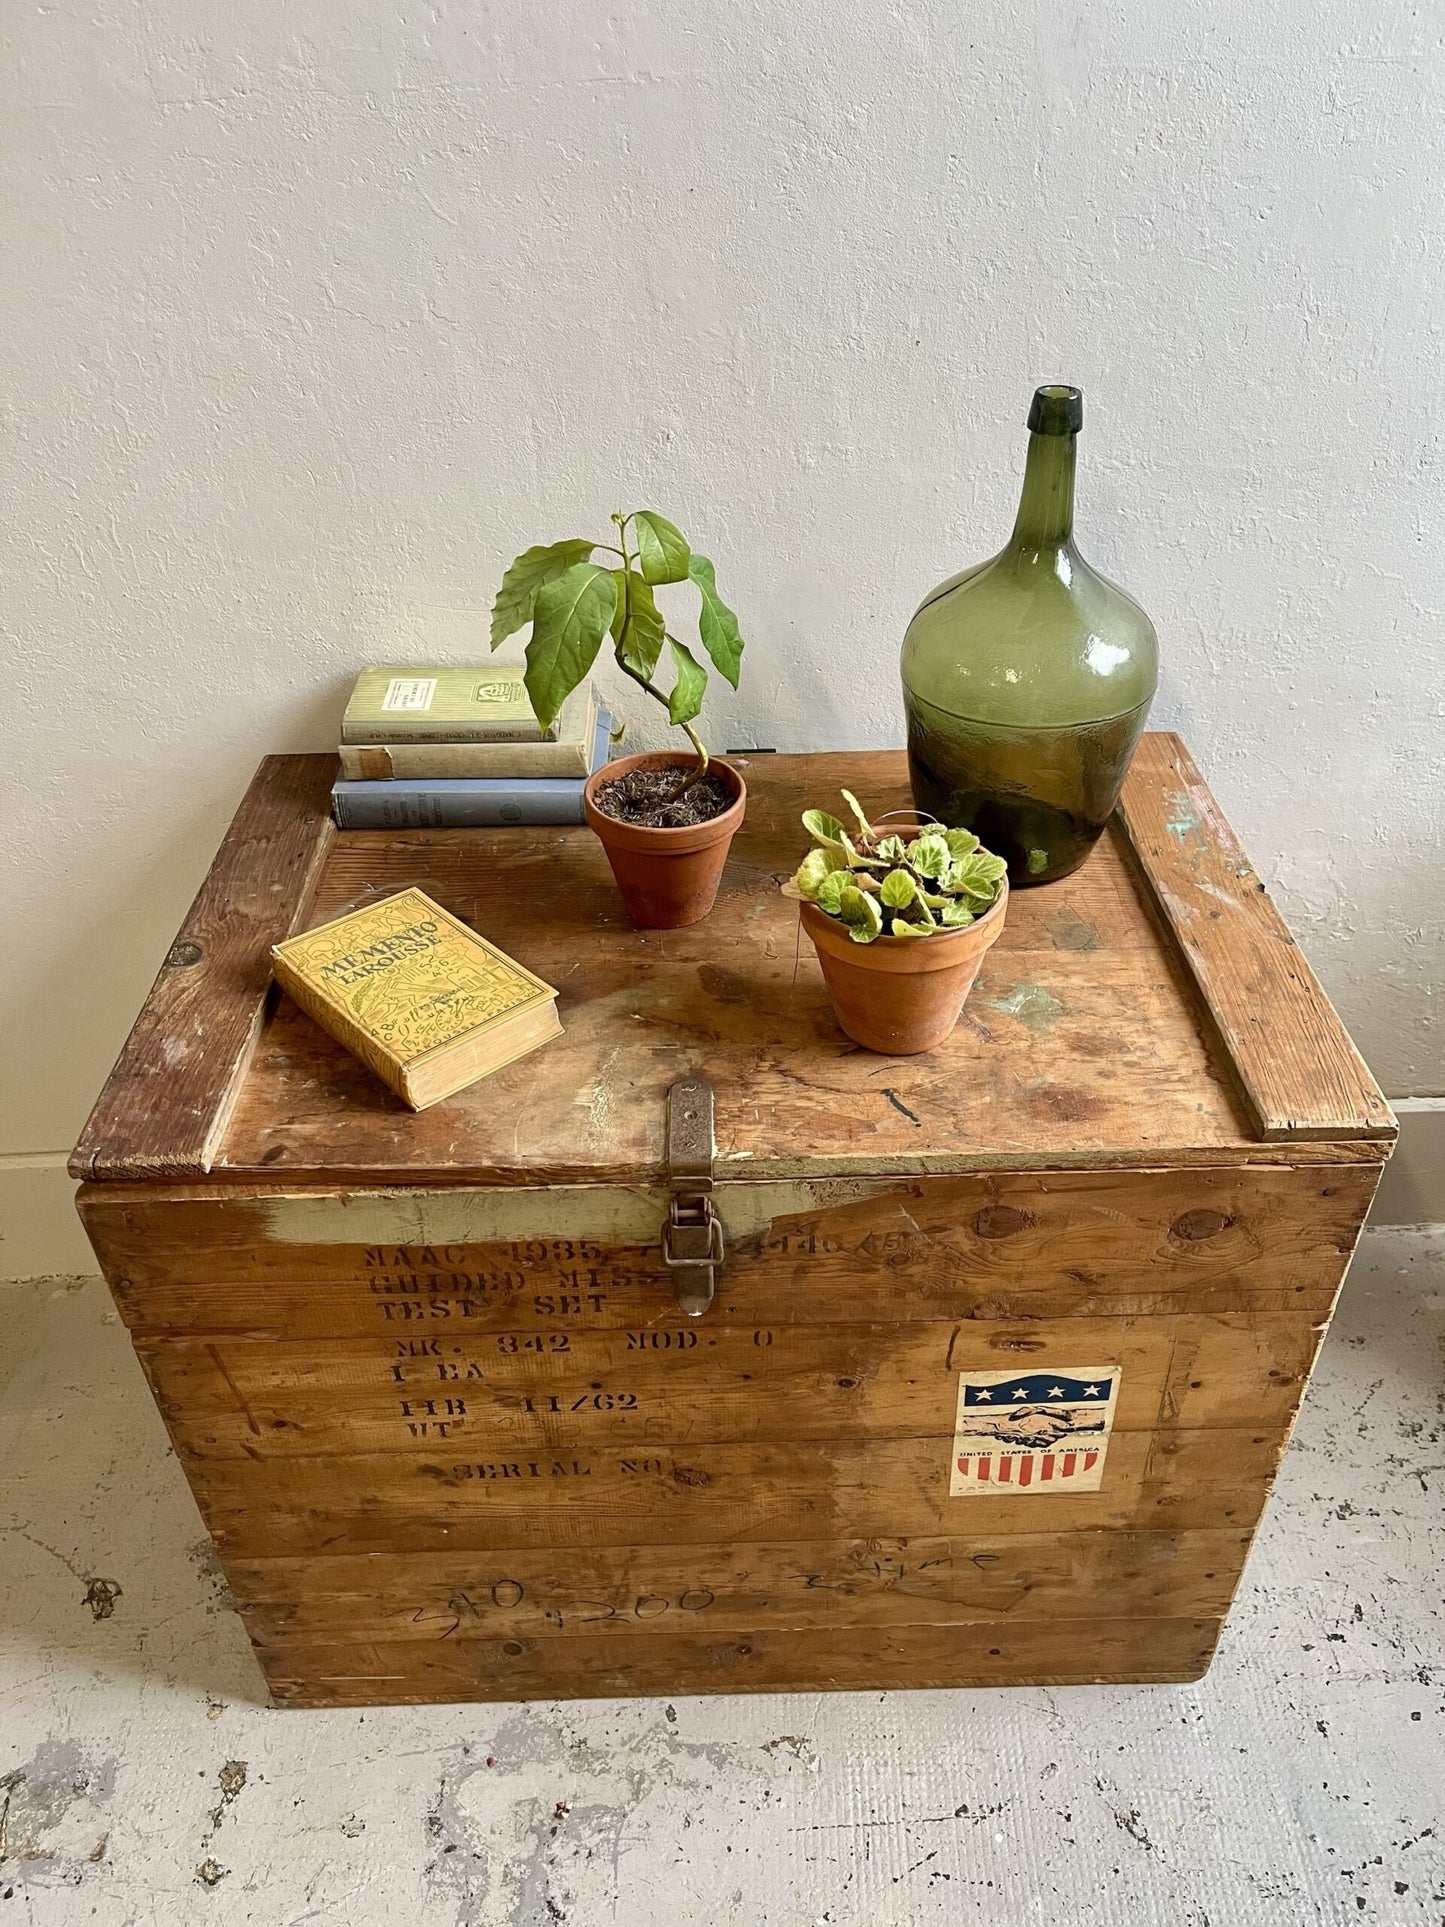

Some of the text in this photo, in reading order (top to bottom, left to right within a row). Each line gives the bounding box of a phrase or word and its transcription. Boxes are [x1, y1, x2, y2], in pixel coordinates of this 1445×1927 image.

[321, 921, 438, 980] MEMENTO
[339, 935, 442, 985] LAROUSSE
[369, 1270, 527, 1294] GUIDED
[376, 1293, 607, 1320] TEST SET
[497, 1335, 571, 1353] 342
[437, 1363, 484, 1380] EA
[452, 1461, 592, 1479] SERIAL
